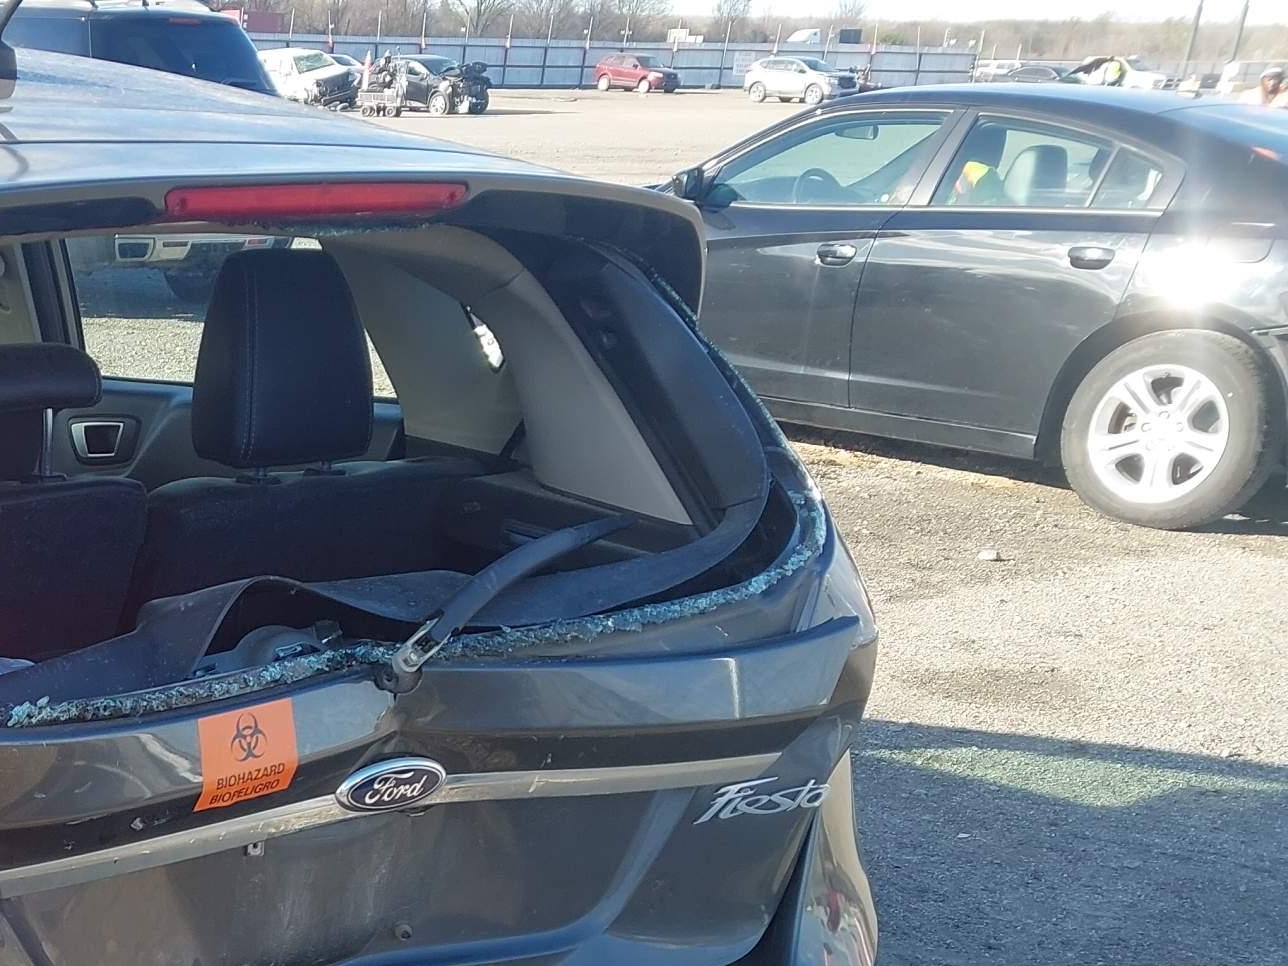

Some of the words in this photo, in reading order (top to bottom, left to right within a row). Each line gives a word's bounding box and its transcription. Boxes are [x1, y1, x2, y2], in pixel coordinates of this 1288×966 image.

[215, 762, 286, 790] BIOHAZARD
[364, 771, 428, 804] Ford
[208, 779, 281, 805] BIOPELIGRO
[692, 776, 831, 825] Fiesta
